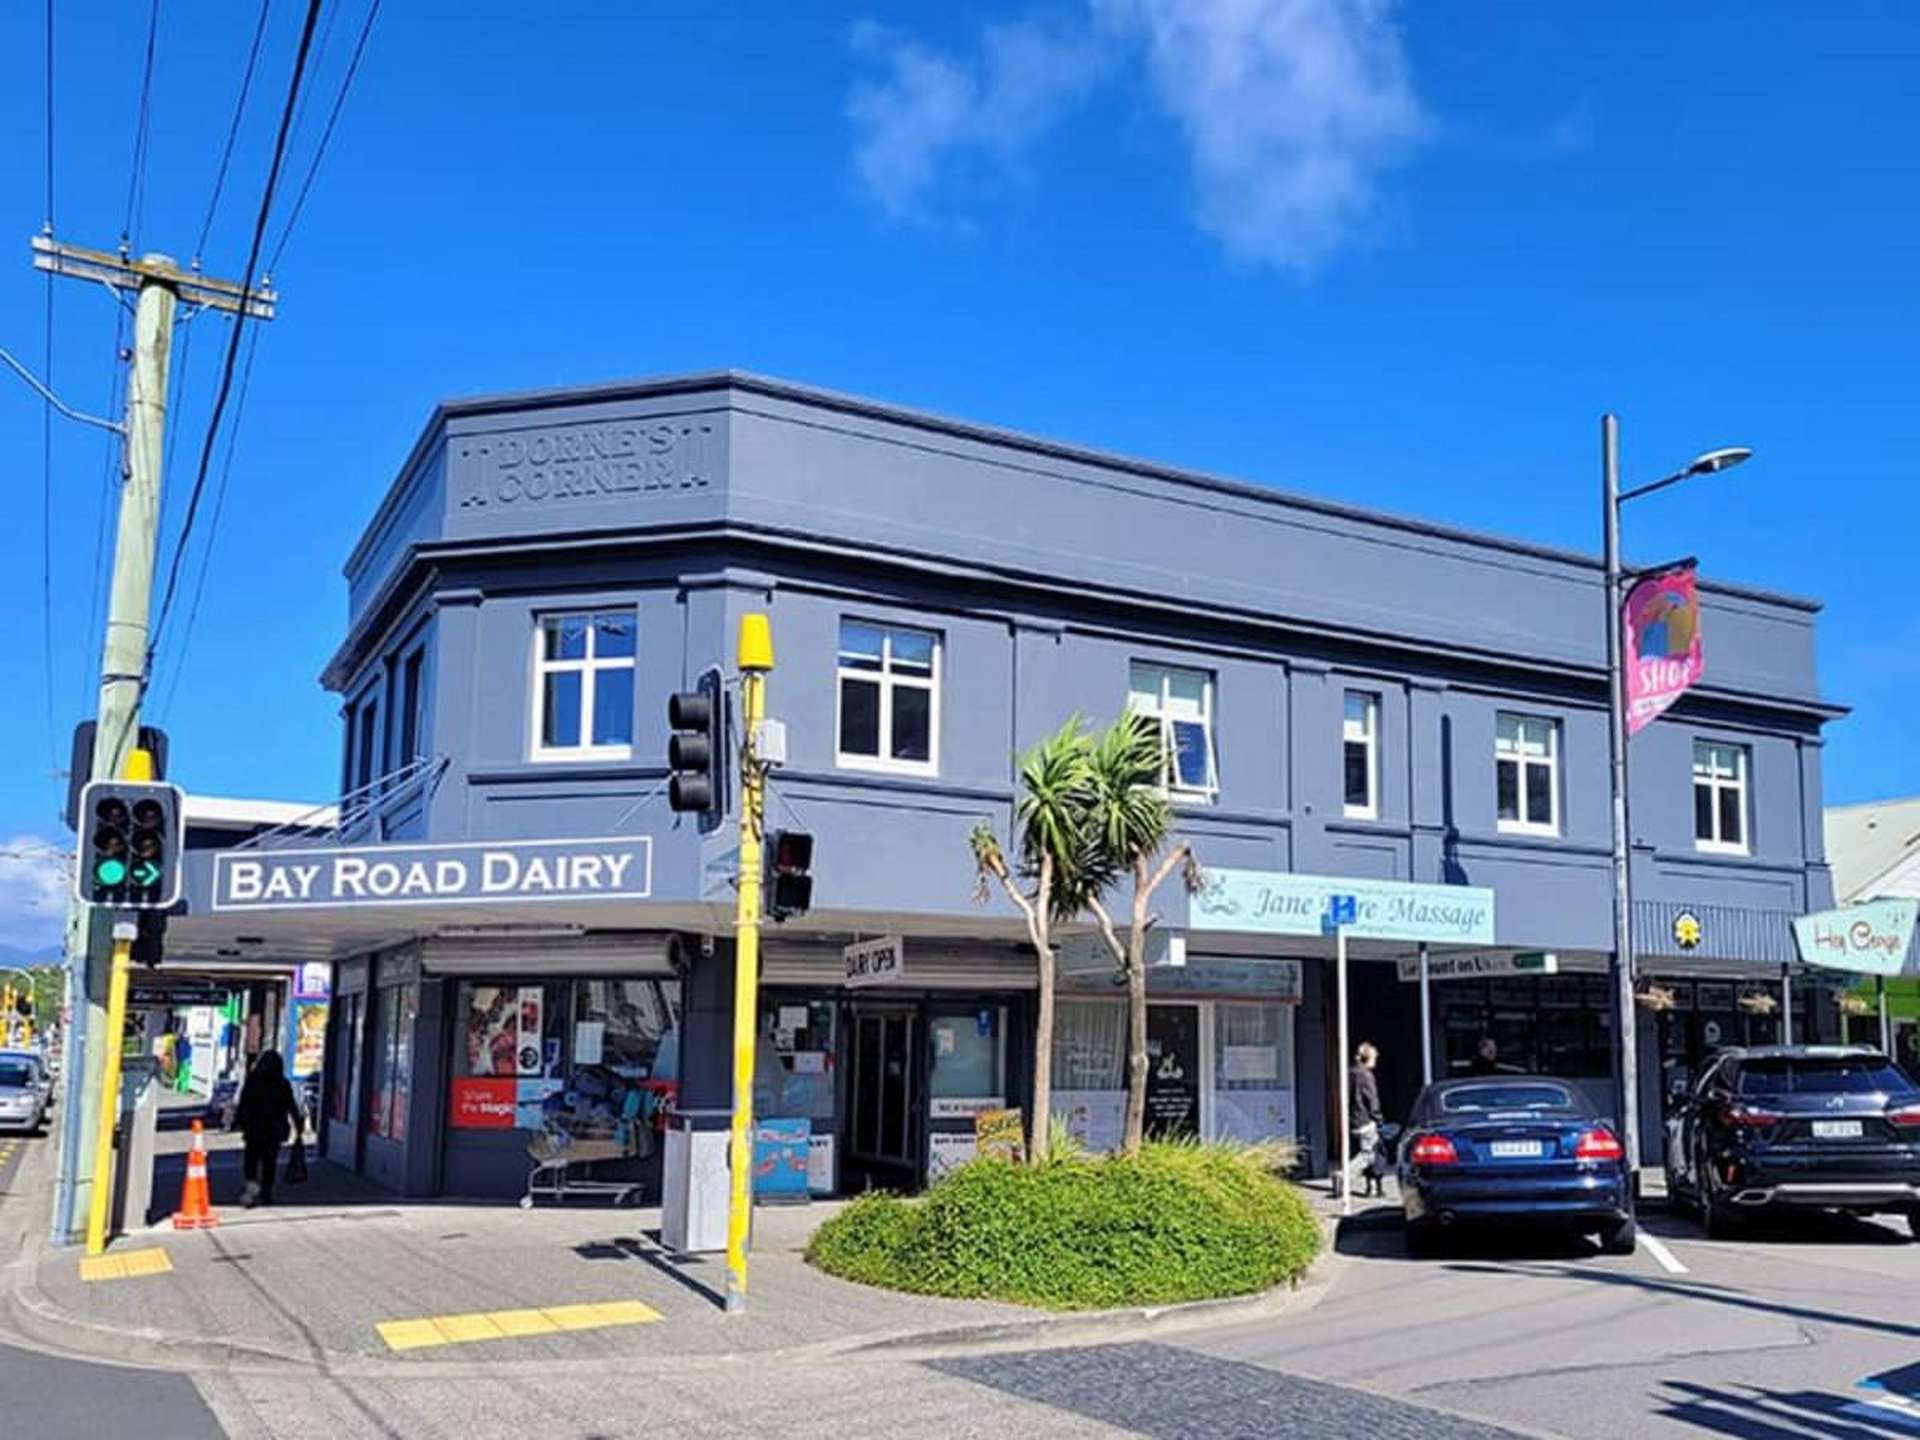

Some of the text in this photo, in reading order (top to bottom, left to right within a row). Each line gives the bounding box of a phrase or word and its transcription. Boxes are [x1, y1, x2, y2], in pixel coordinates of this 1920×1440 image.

[498, 459, 673, 502] CORNER
[229, 851, 634, 899] BAY ROAD DAIRY
[1253, 888, 1313, 917] Jane
[1388, 896, 1485, 935] Massage
